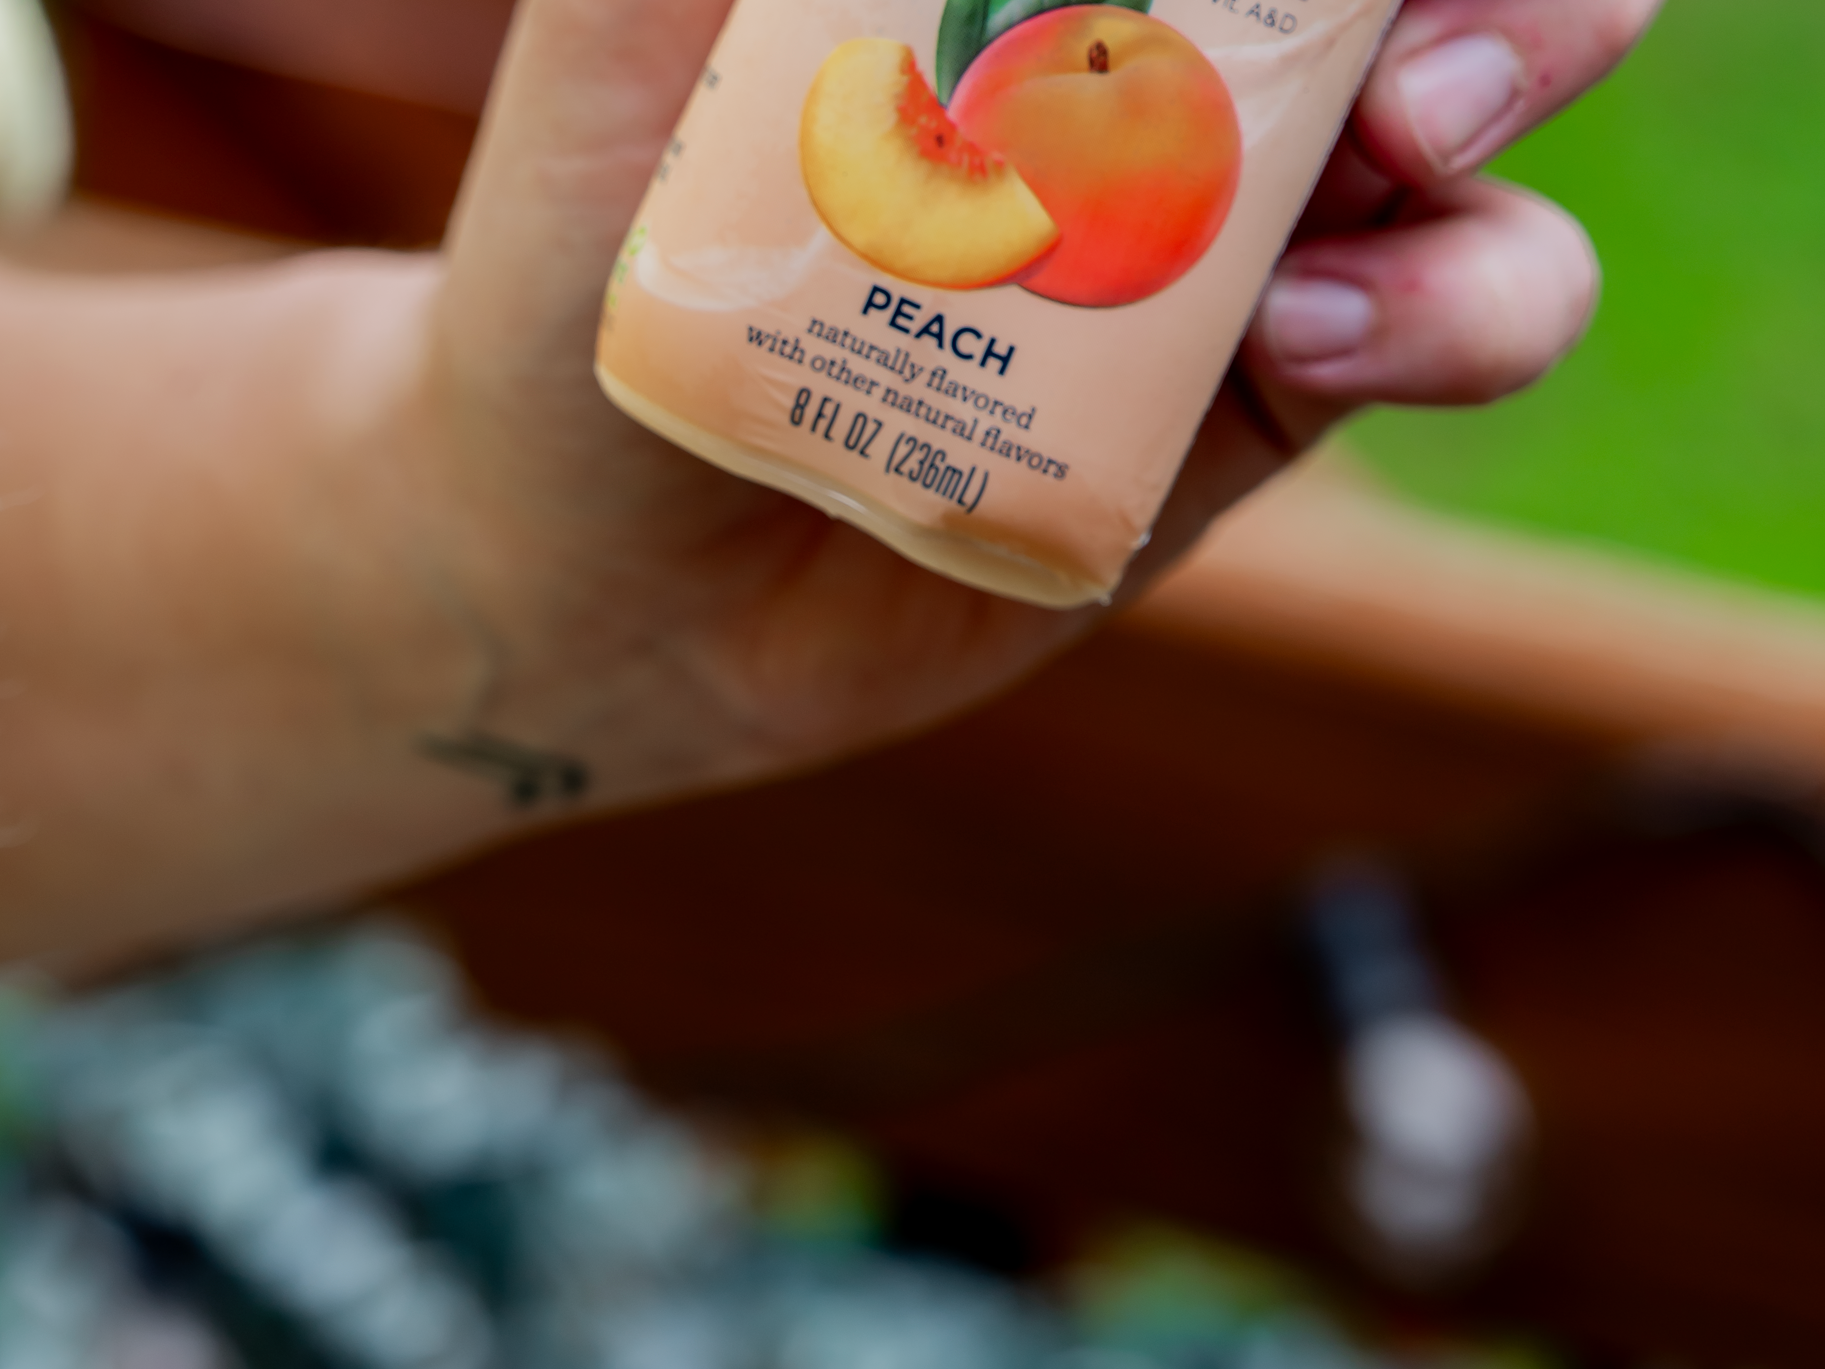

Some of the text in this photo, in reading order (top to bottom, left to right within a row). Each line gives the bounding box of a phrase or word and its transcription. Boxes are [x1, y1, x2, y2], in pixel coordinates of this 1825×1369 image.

[1244, 2, 1298, 35] A&D
[807, 317, 1037, 430] naturally flavored
[861, 284, 1016, 376] PEACH
[746, 325, 1069, 480] with other natural flavors
[790, 387, 989, 514] 8 FL OZ (236mL)
